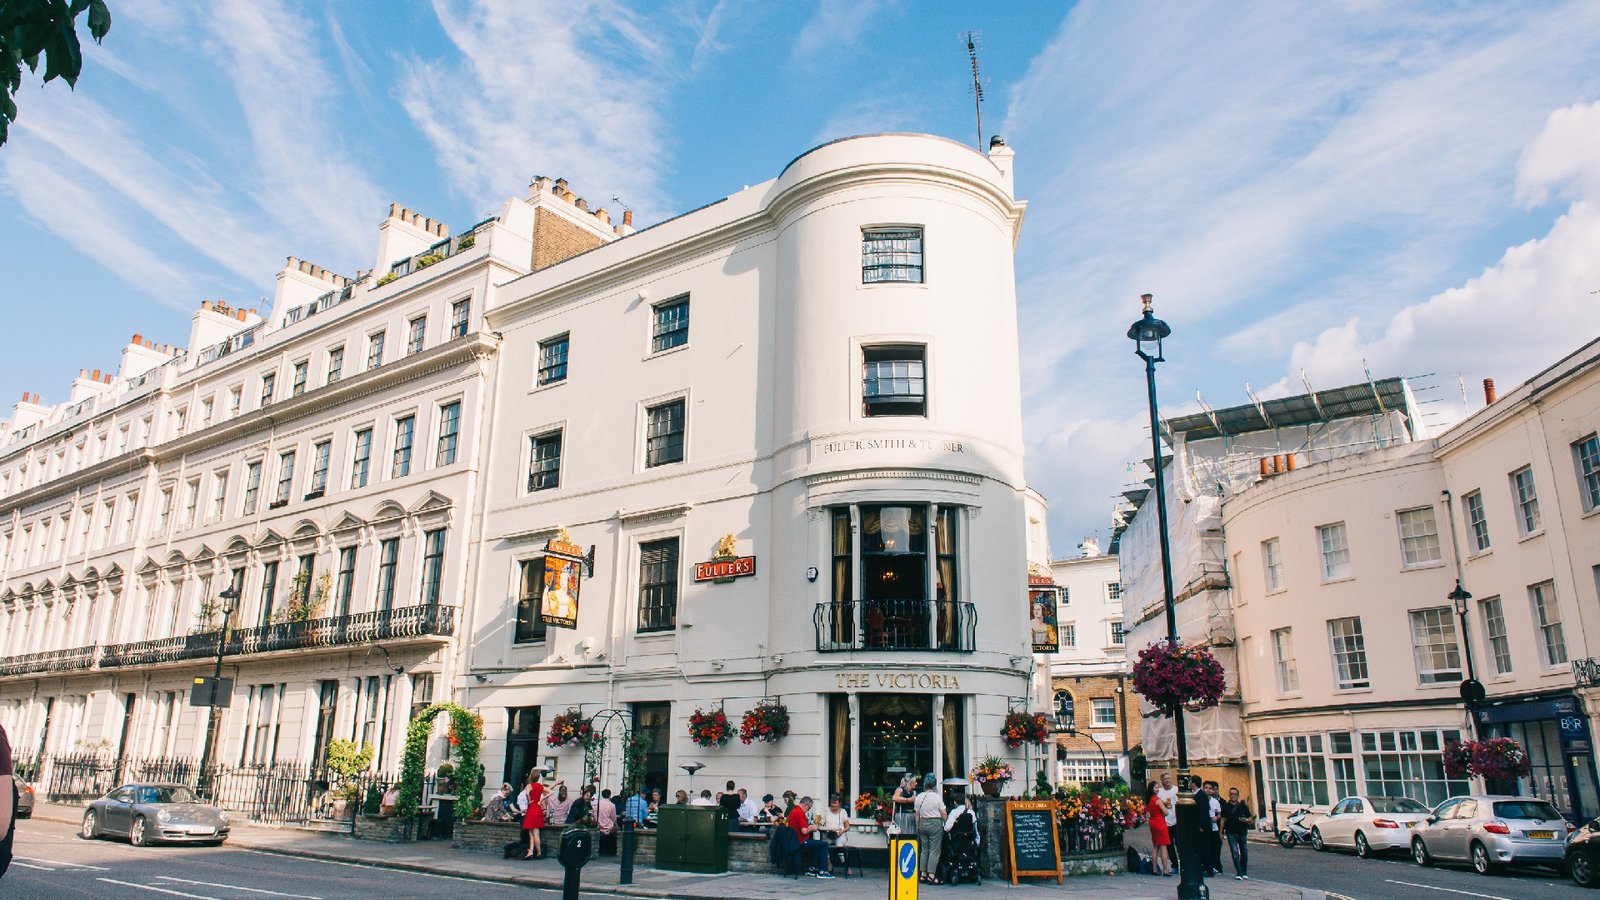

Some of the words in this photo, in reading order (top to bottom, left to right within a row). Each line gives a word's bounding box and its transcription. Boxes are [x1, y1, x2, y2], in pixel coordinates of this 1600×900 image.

[867, 439, 905, 450] SMITH
[908, 439, 917, 449] &
[553, 617, 574, 626] VICTORIA
[835, 673, 871, 688] THE
[876, 673, 960, 689] VICTORIA
[1561, 716, 1582, 731] B&R
[576, 839, 582, 848] 2
